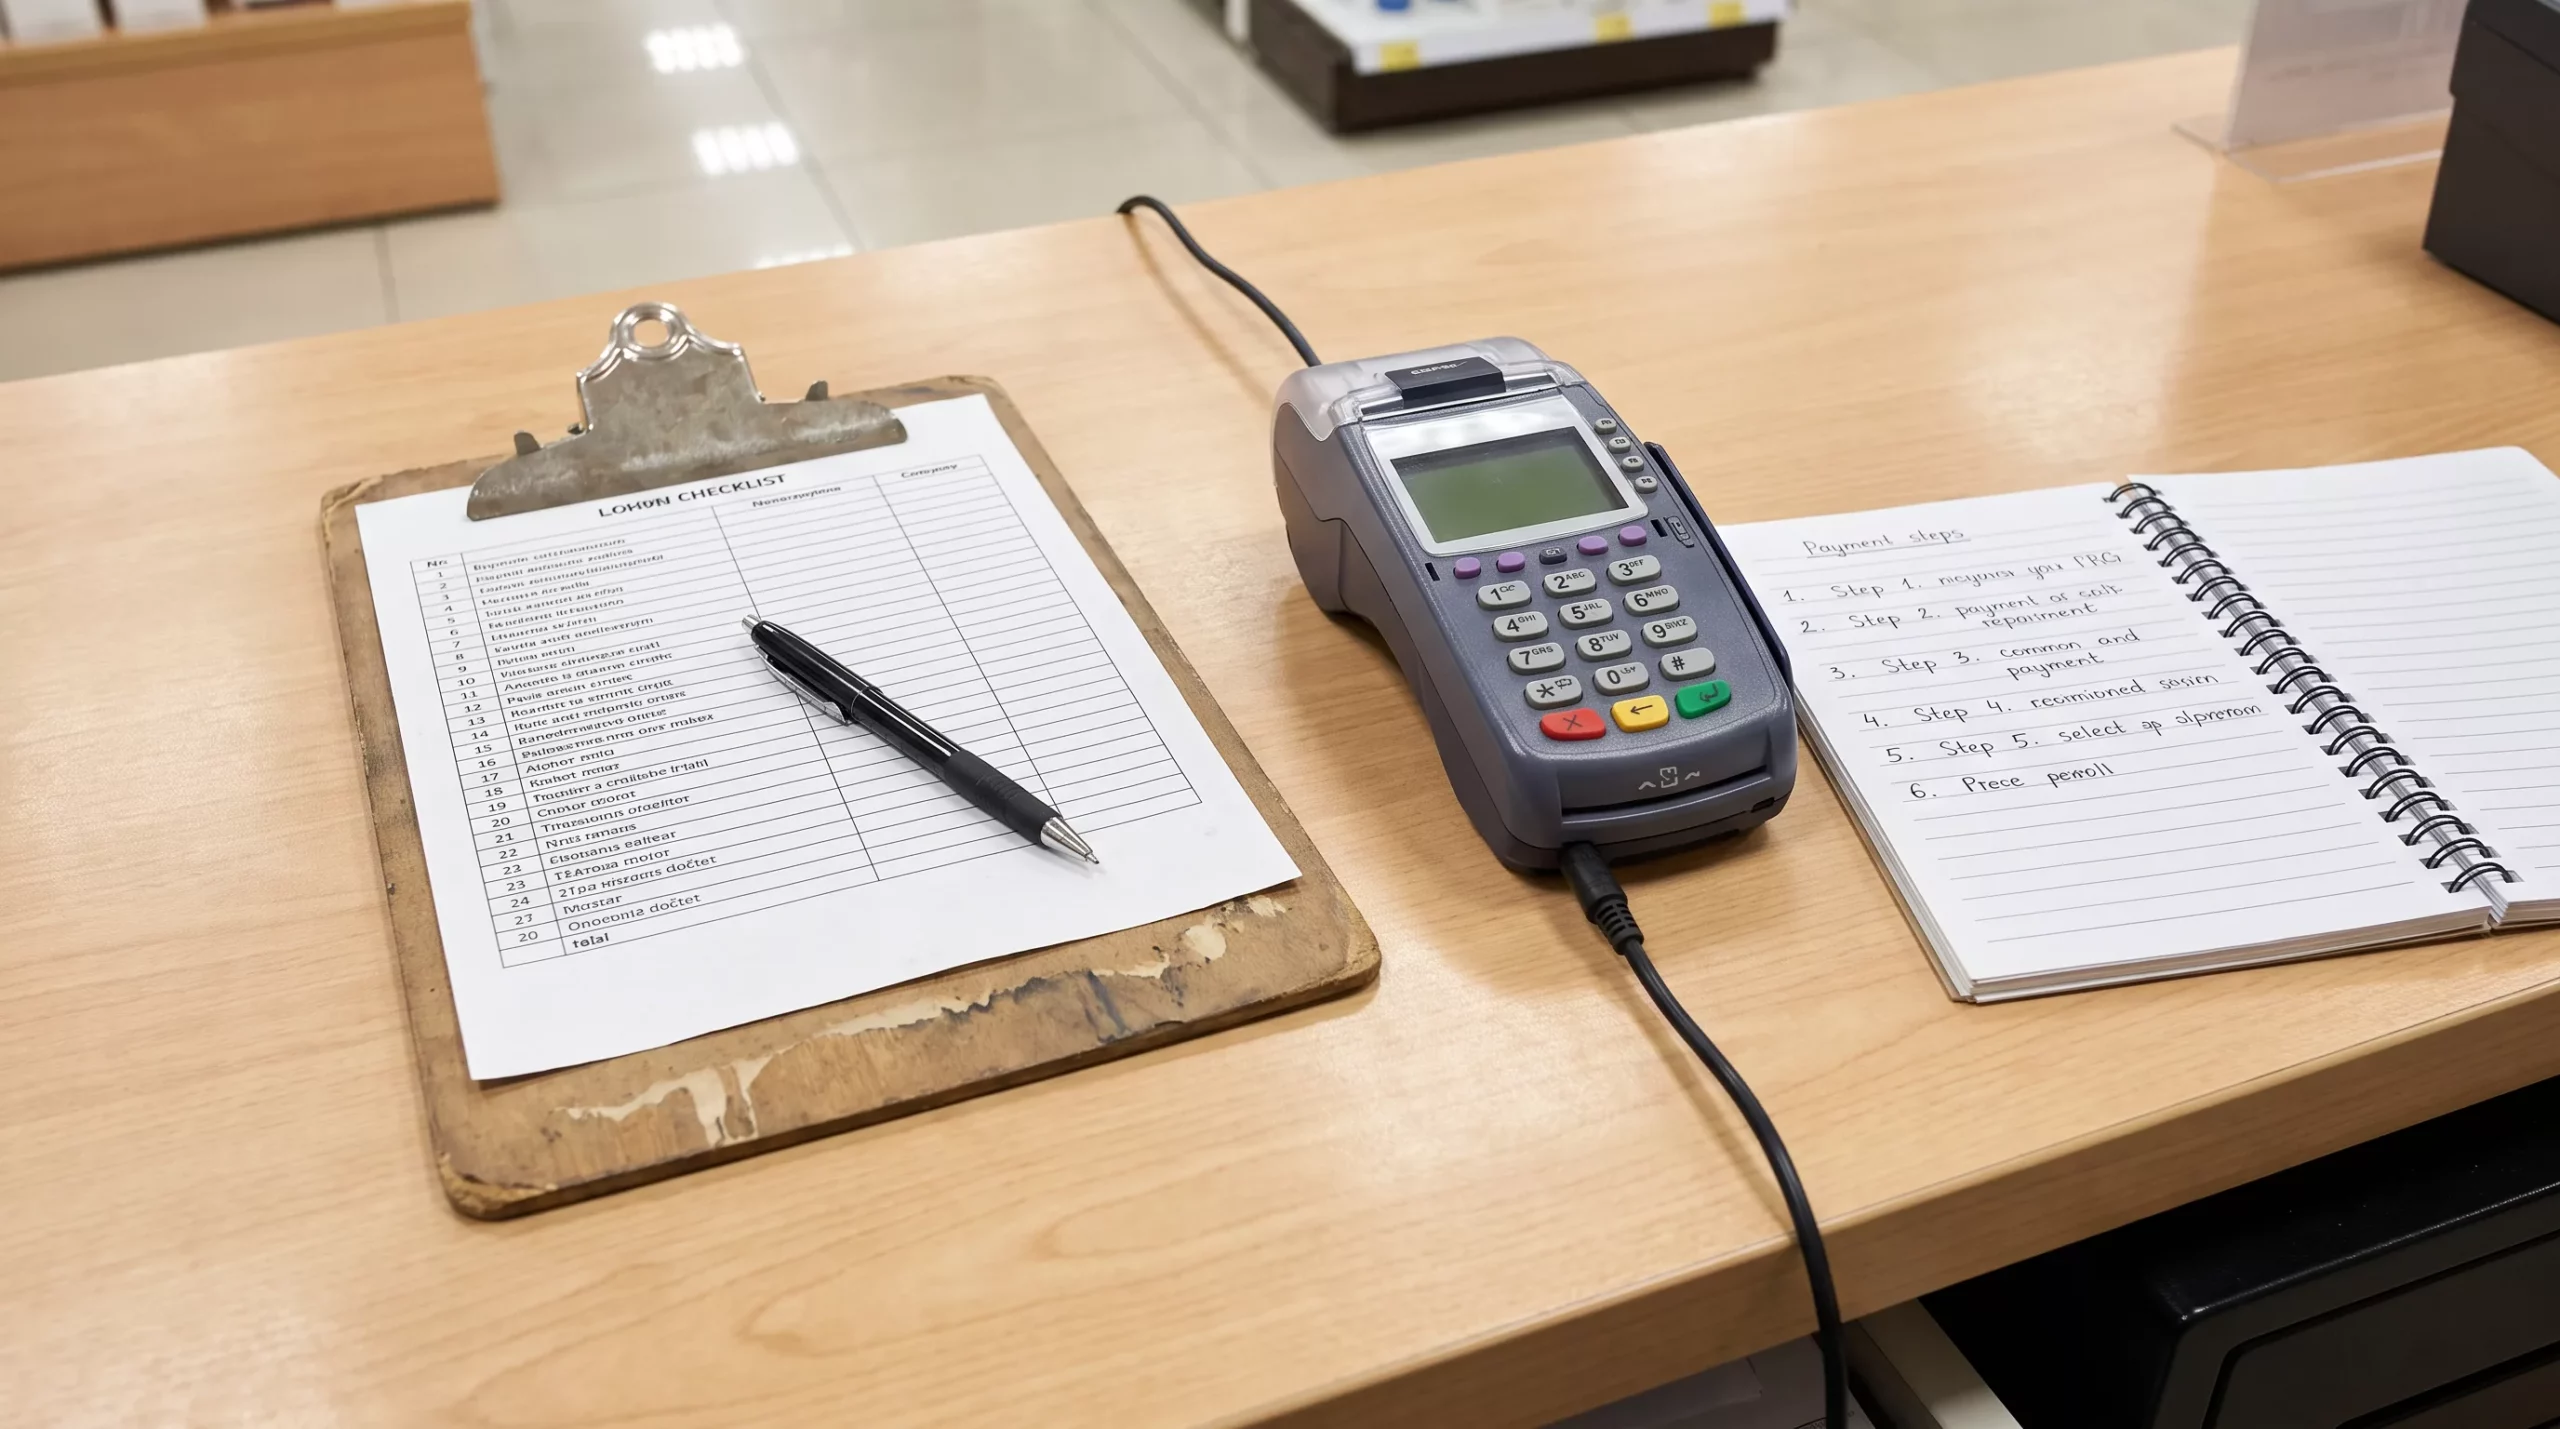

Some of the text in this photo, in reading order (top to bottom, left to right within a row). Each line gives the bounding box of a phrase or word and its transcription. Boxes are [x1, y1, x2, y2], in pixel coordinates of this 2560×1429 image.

[678, 474, 787, 502] CHECKLIST
[1802, 528, 1965, 558] Payment steps
[1618, 562, 1633, 577] 3
[440, 582, 447, 590] 2
[1554, 576, 1570, 590] 2
[1784, 590, 1805, 602] 1.
[1831, 584, 1885, 600] Step
[1902, 577, 1922, 590] 1.
[1490, 588, 1503, 601] 1
[1634, 593, 1649, 607] 6
[1571, 606, 1586, 620] 5
[1801, 620, 1826, 633] 2.
[1849, 614, 1902, 631] Step
[1918, 607, 1941, 621] 2.
[1955, 595, 2039, 620] payment
[1507, 618, 1520, 633] 4
[1651, 624, 1667, 639] 9
[452, 640, 460, 648] 7
[1588, 633, 1620, 652] 8 TUV
[1519, 650, 1531, 665] 7
[1830, 666, 1856, 680] 3.
[1881, 658, 1938, 675] Step
[1953, 650, 1980, 665] 3.
[2098, 628, 2141, 646] and
[457, 665, 467, 673] 9
[2007, 652, 2105, 681] payment
[457, 677, 476, 687] 10
[1606, 669, 1621, 684] 0
[460, 690, 478, 700] 11
[464, 703, 482, 713] 12
[1863, 713, 1889, 728] 4.
[1914, 707, 1969, 724] Step
[1986, 699, 2012, 713] 4.
[468, 716, 486, 727] 13
[471, 730, 489, 741] 14
[1886, 747, 1915, 763] 5.
[1939, 741, 1995, 758] Step
[2012, 733, 2039, 749] 5.
[2058, 720, 2127, 743] select
[474, 744, 492, 755] 15
[478, 758, 496, 769] 16
[480, 772, 499, 784] 17
[484, 786, 504, 798] 18
[1910, 782, 1938, 799] 6.
[488, 801, 507, 813] 19
[491, 816, 511, 828] 20
[495, 832, 515, 844] 21
[498, 848, 518, 860] 22
[506, 880, 526, 892] 23
[510, 896, 530, 908] 24
[518, 930, 539, 943] 20
